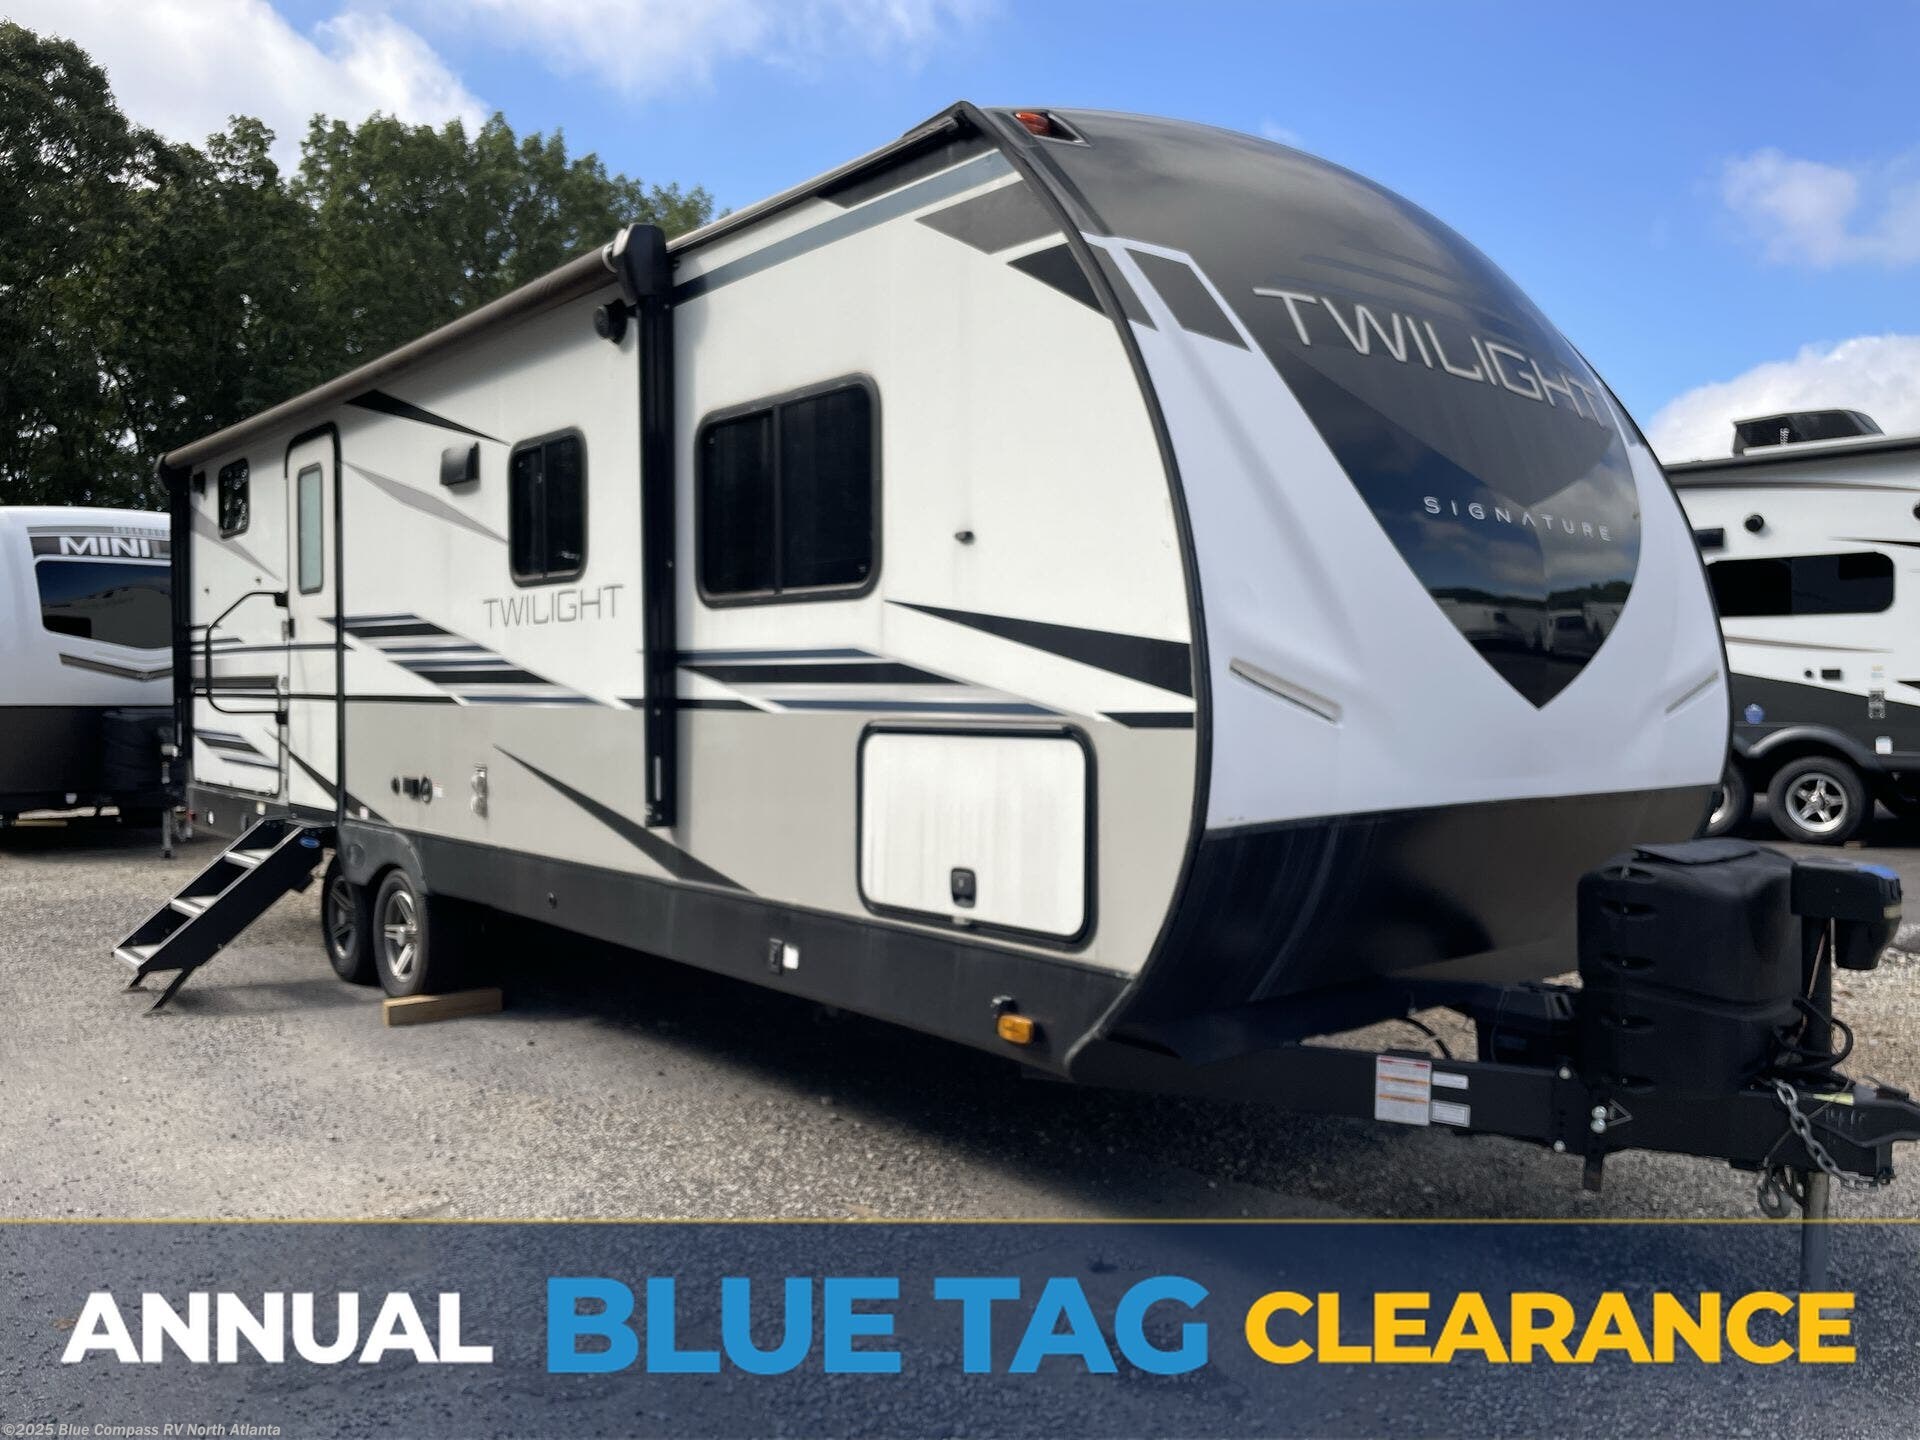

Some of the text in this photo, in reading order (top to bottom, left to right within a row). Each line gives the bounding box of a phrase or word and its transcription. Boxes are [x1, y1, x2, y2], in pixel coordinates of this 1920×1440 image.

[1252, 287, 1606, 431] TWILIGHT
[1423, 495, 1614, 541] SIGNATURE
[483, 583, 624, 629] TWILIGHT
